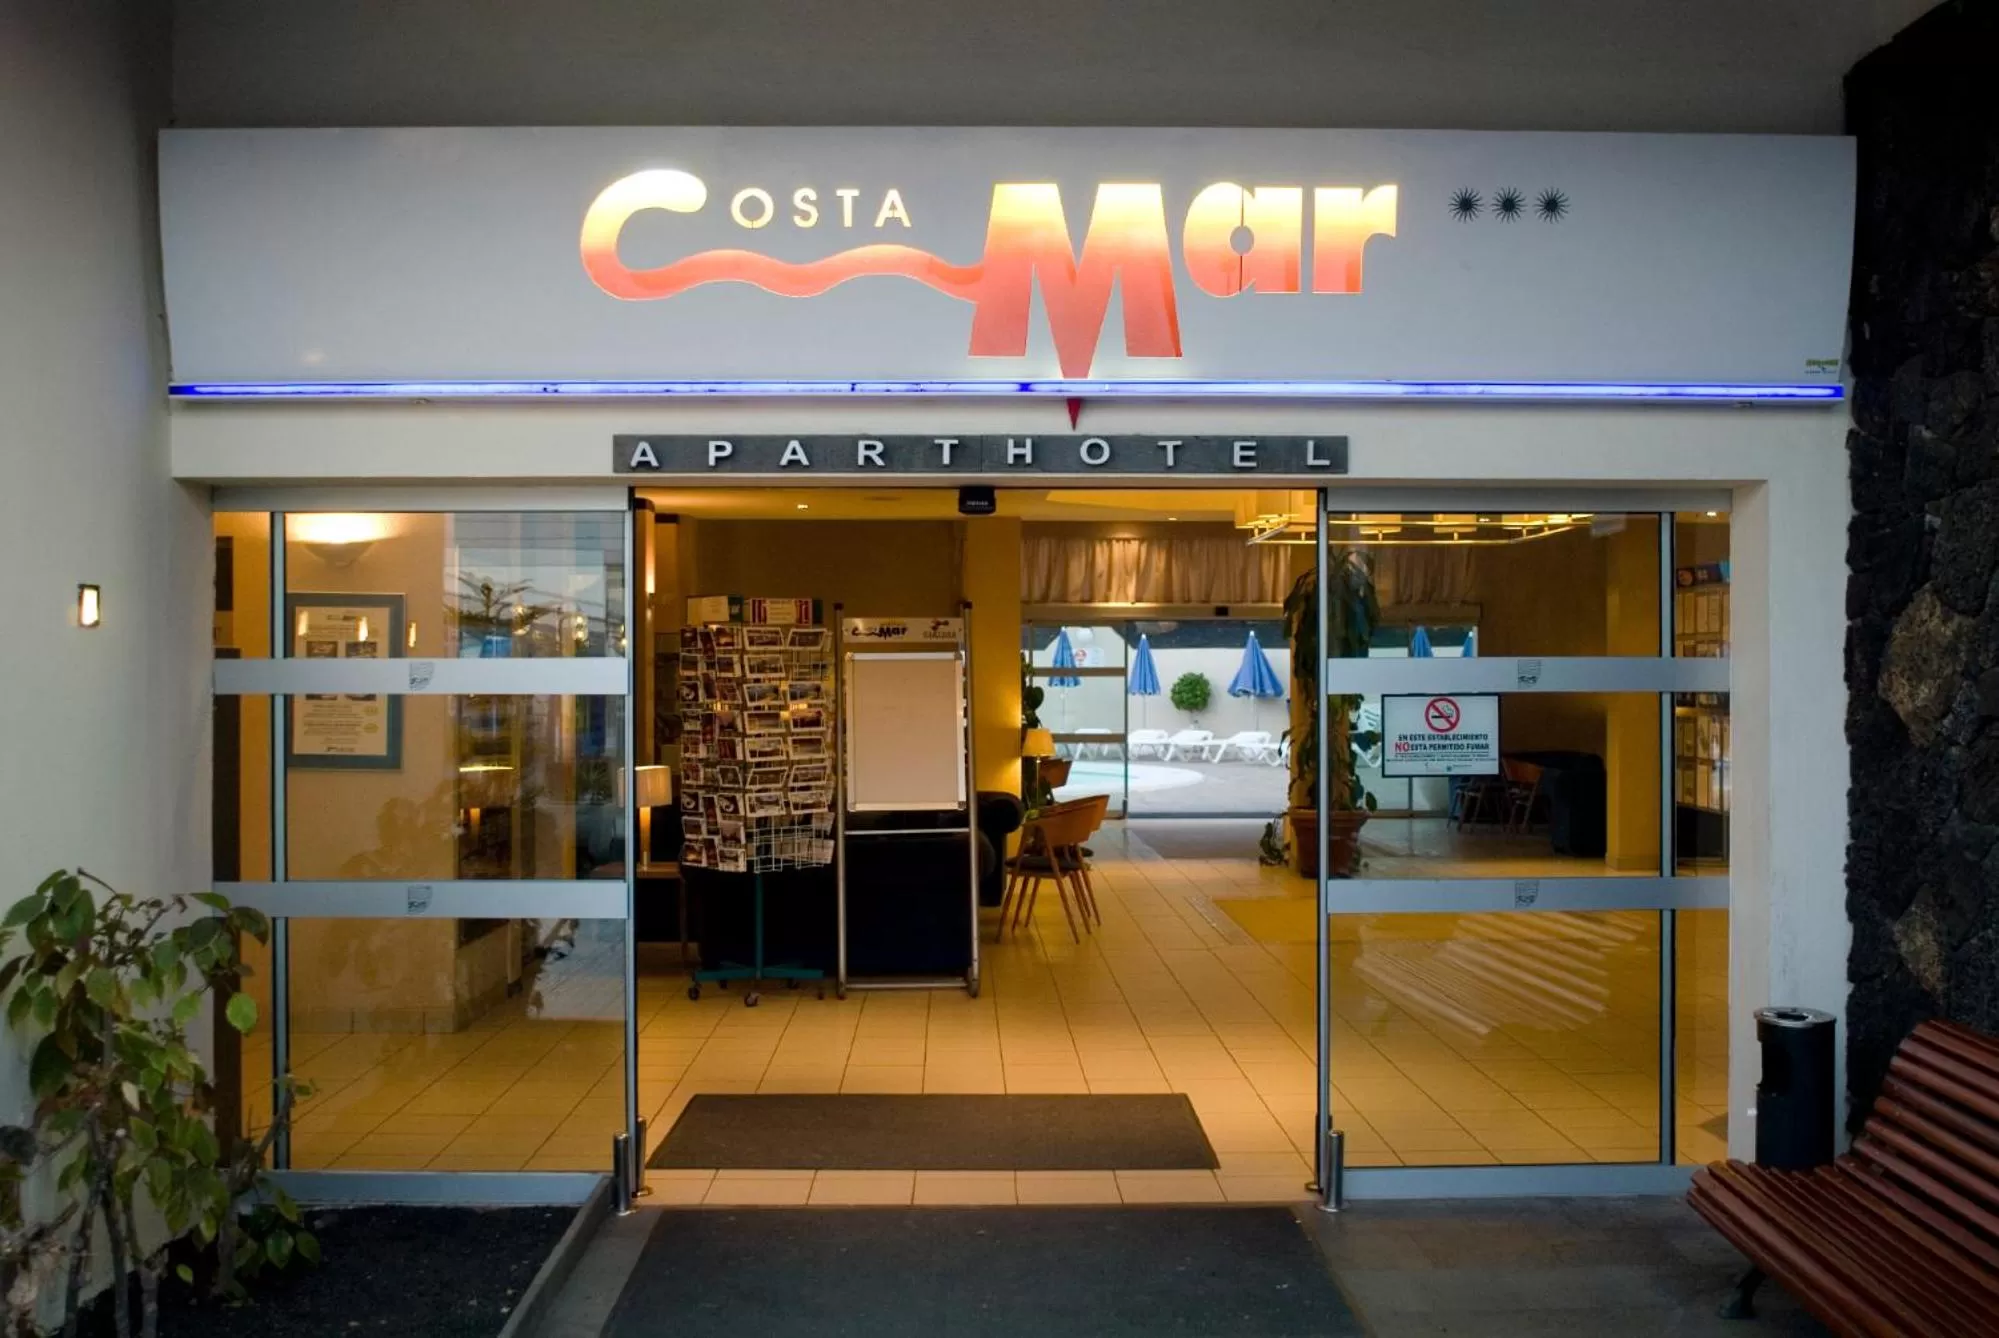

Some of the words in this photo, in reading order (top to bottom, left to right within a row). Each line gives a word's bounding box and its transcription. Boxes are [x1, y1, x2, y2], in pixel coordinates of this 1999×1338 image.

[968, 182, 1398, 380] Mar
[630, 437, 1331, 467] APARTHOTEL
[1394, 742, 1410, 752] NO
[1428, 743, 1465, 751] PERMITIDO
[1466, 743, 1490, 751] FUMAR
[1427, 733, 1489, 741] ESTABLECIMIENTO
